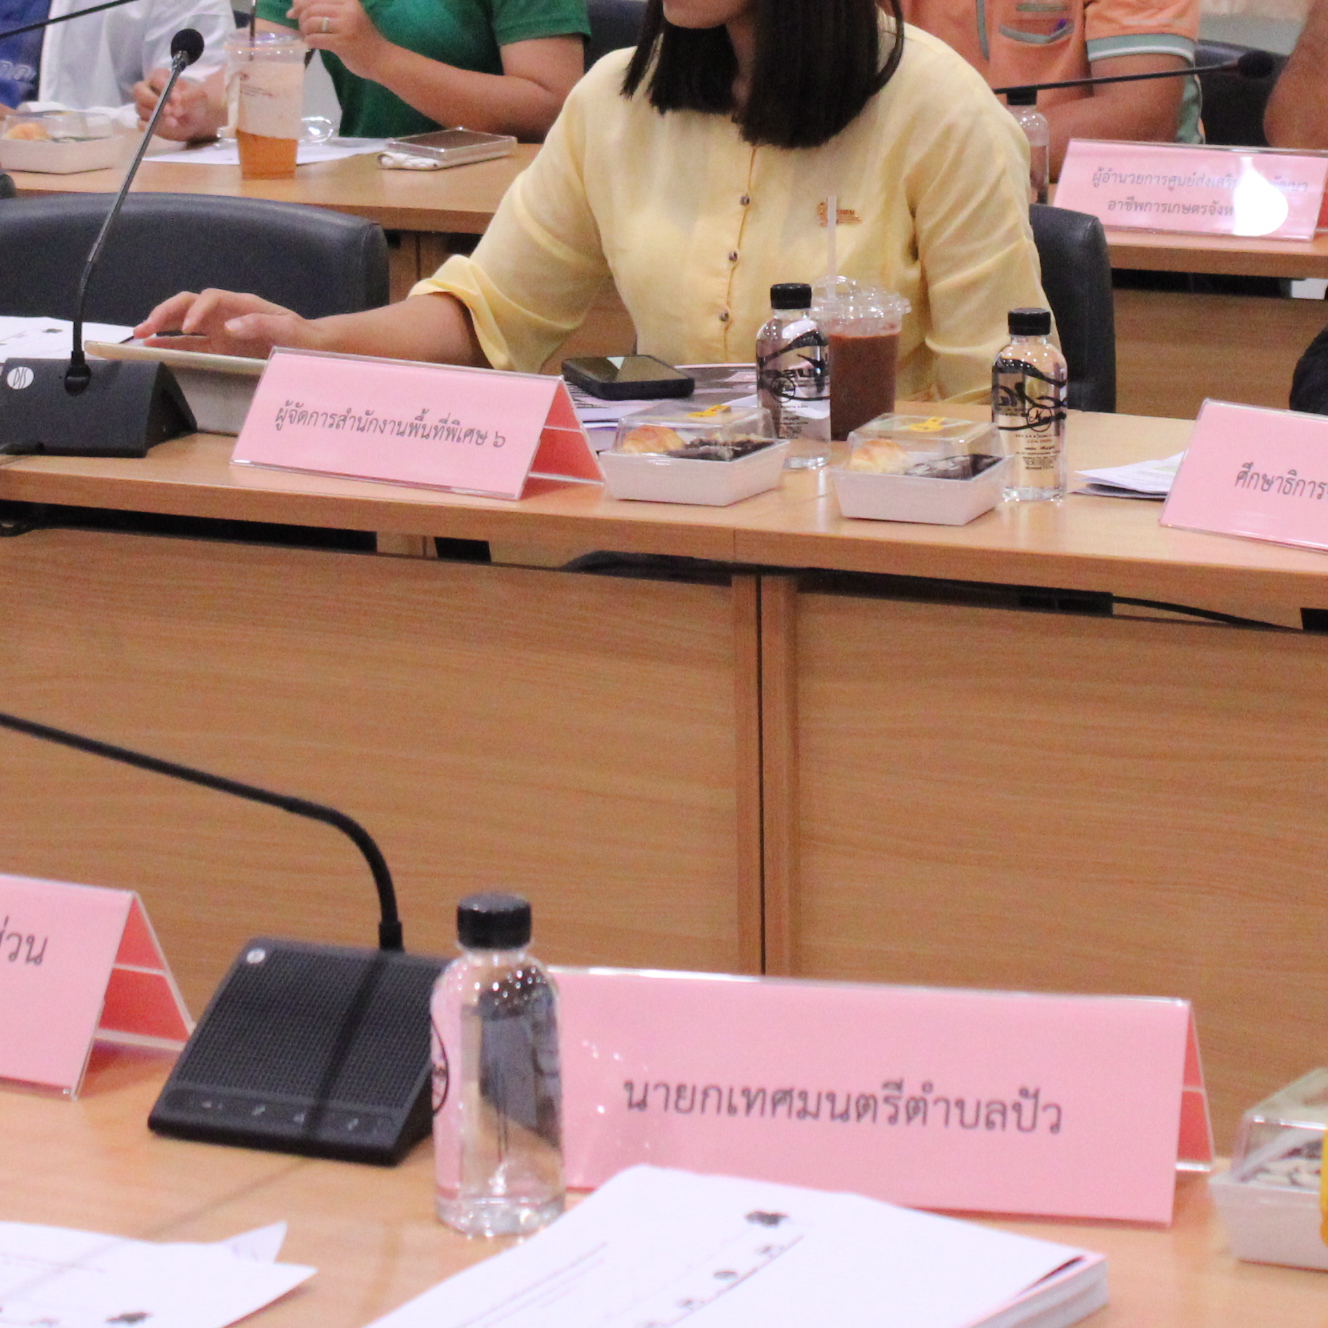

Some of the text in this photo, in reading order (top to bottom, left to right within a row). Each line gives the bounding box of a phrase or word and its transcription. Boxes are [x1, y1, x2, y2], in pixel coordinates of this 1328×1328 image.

[275, 400, 488, 446] ผู้จัดการสำนักงานพื้นที่พิเศษ
[623, 1078, 1063, 1135] นายกเทศมนตรีตำบลปัว
